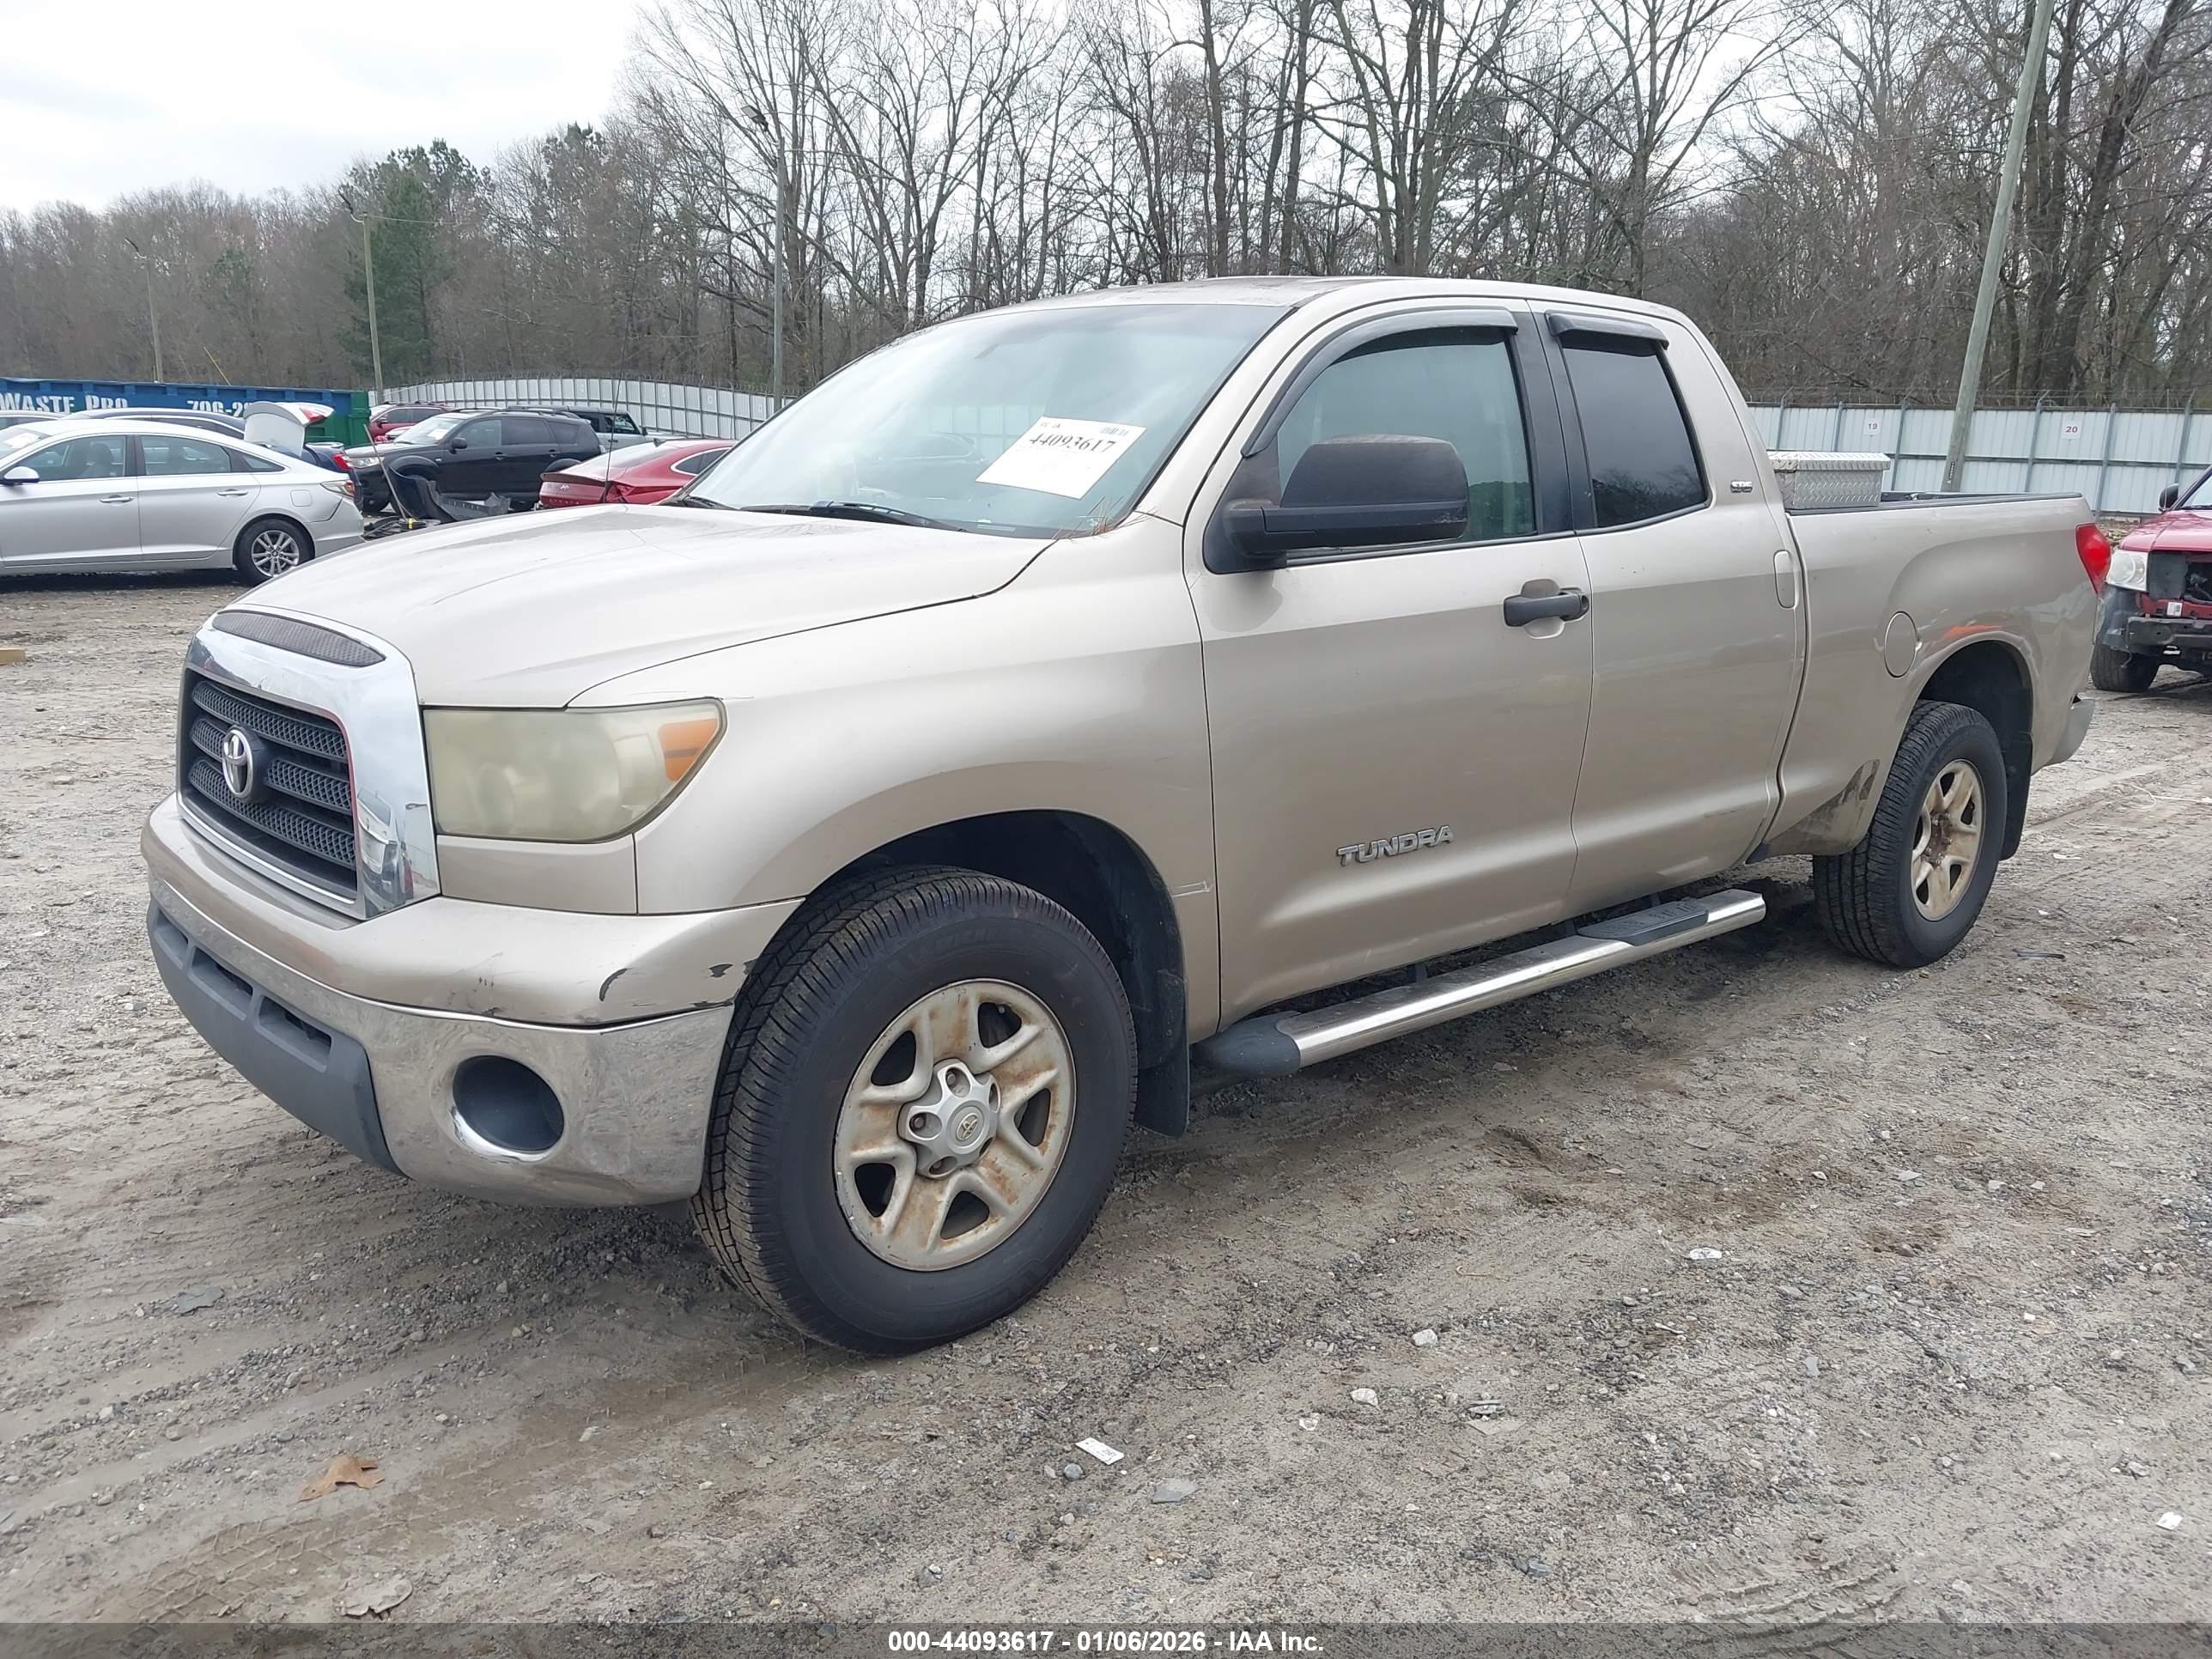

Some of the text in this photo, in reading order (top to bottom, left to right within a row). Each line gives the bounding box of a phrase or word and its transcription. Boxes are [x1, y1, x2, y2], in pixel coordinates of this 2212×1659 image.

[0, 392, 129, 414] WASTE PRO
[1029, 433, 1117, 453] 44093617
[1336, 825, 1455, 866] TUNDRA
